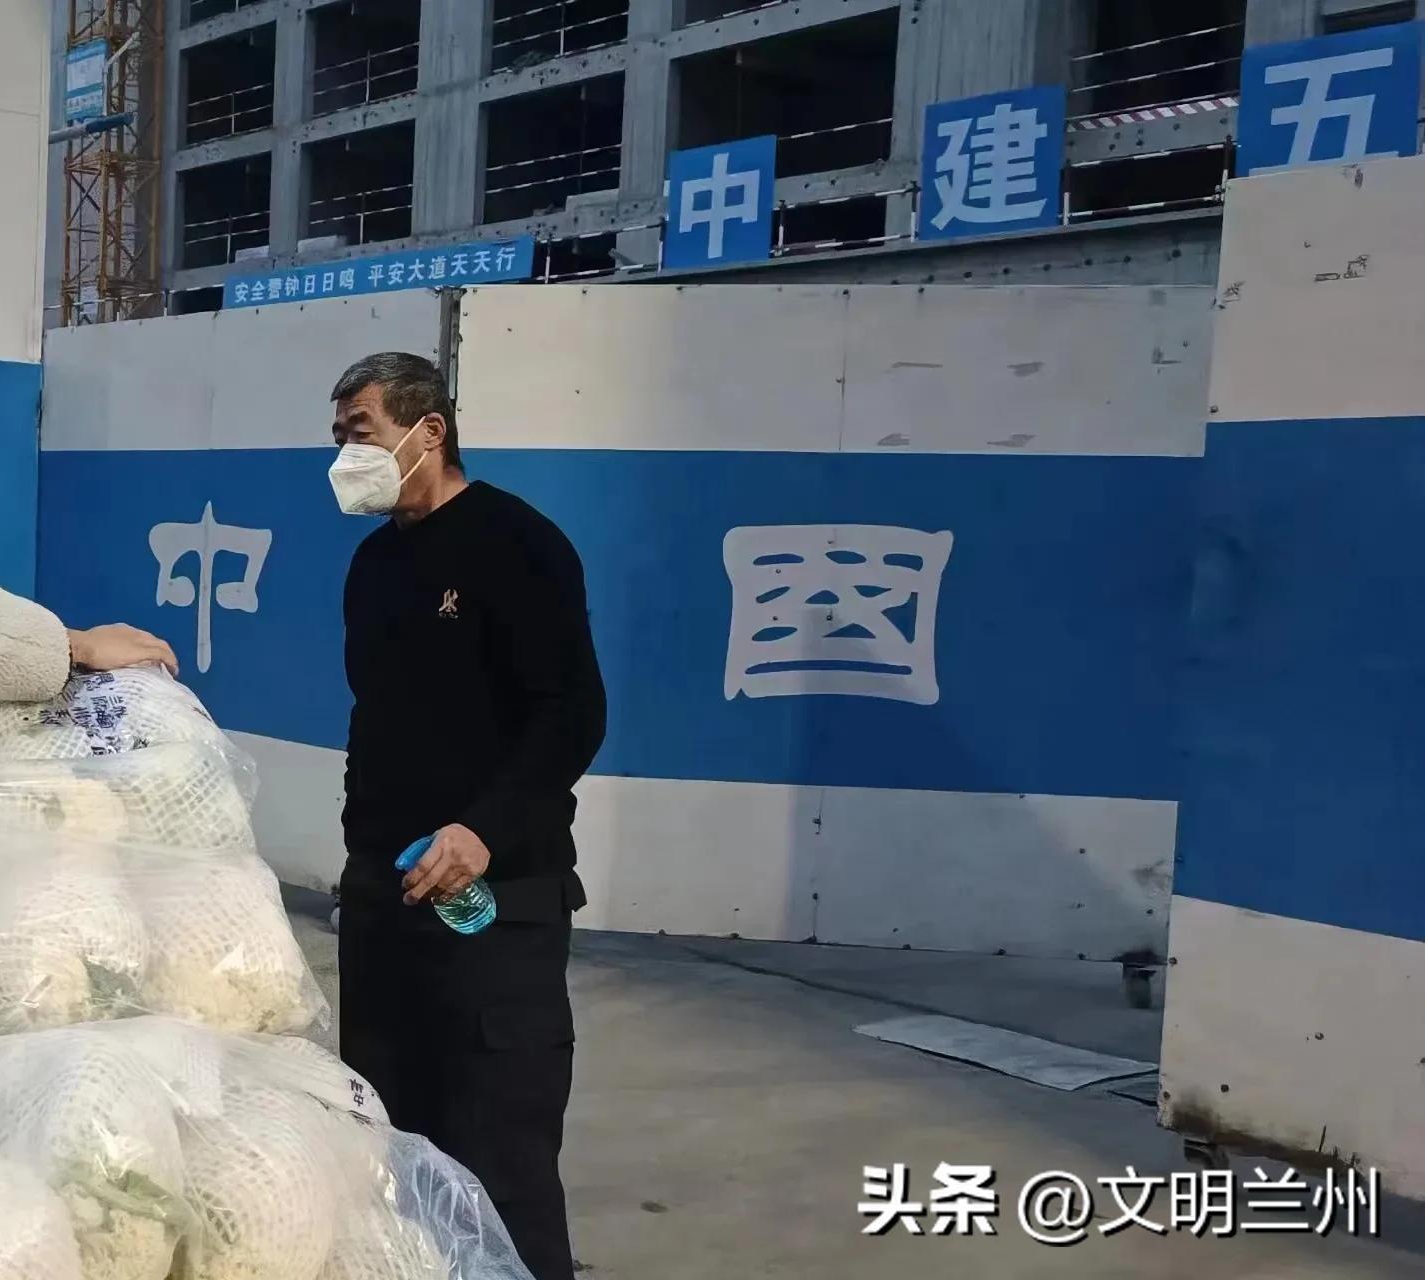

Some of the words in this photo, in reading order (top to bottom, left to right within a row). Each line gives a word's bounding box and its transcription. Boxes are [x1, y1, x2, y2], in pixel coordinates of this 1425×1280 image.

[679, 152, 761, 259] 中
[930, 103, 1048, 231] 建
[1248, 47, 1400, 177] 五
[367, 246, 516, 287] 平安大道天天行
[148, 500, 273, 673] 中
